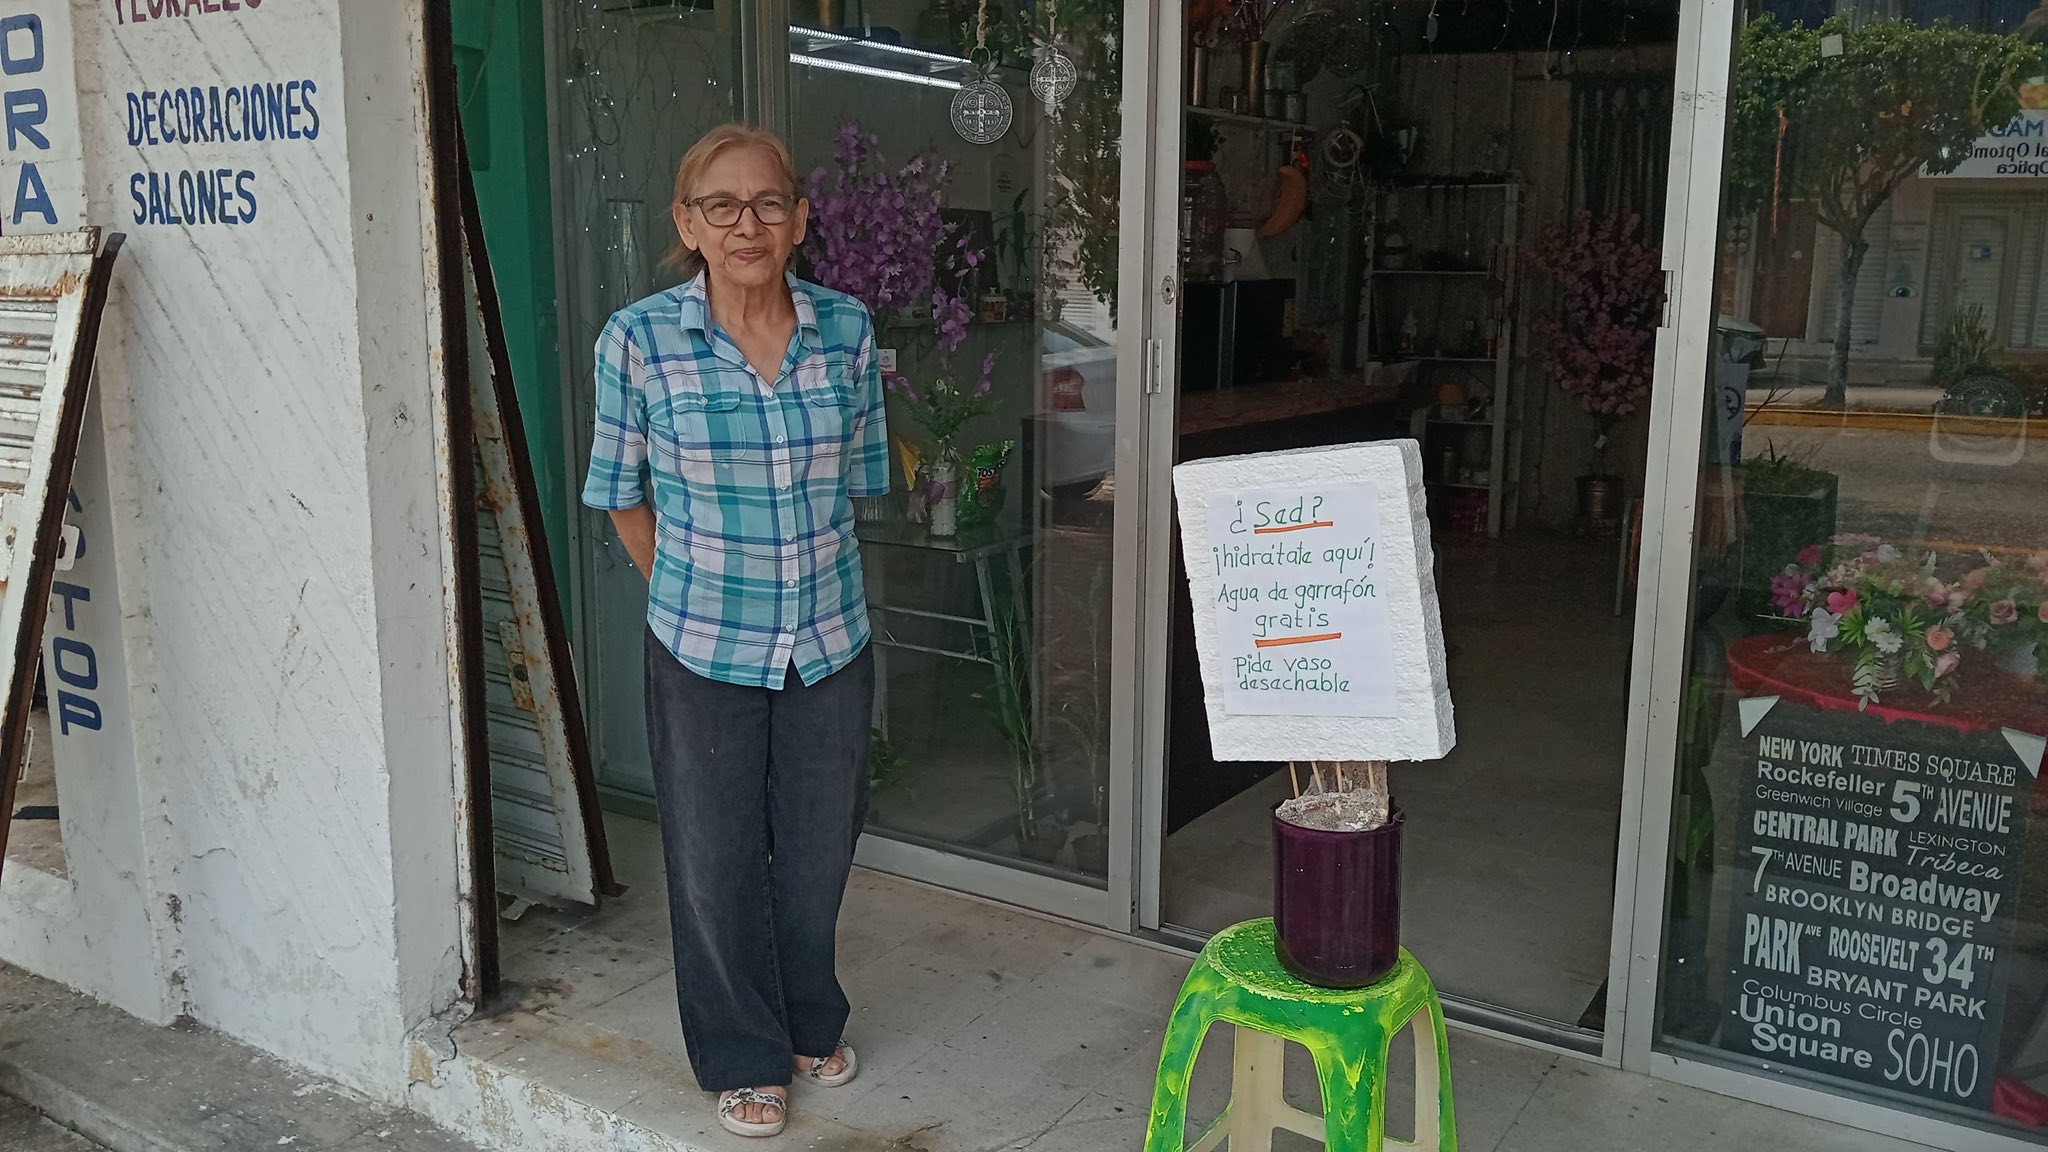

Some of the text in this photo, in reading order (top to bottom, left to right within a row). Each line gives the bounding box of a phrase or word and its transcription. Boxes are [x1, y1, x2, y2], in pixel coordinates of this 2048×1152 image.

[126, 79, 320, 147] DECORACIONES
[130, 169, 257, 226] SALONES
[1322, 536, 1376, 574] aquí!
[1217, 575, 1377, 612] Agua de garrafón
[1252, 606, 1330, 637] gratis
[1233, 652, 1333, 677] Pide vaso
[1757, 760, 1886, 796] Rockefeller
[1758, 735, 2017, 787] NEW YORK TIMES SQUARE
[1755, 784, 1884, 818] Greenwich Village
[1933, 786, 2014, 834] AVENUE
[1753, 810, 1899, 858] CENTRAL PARK
[1908, 830, 2007, 857] LEXINGTON
[1784, 851, 1843, 880] AVENUE
[1906, 845, 2004, 881] Tribeca
[1765, 883, 1975, 939] BROOKLYN BRIDGE
[1848, 860, 2001, 923] Broadway
[1743, 913, 1805, 976] PARK
[1804, 924, 1823, 938] AVE
[1828, 926, 1920, 973] ROOSEVELT
[1739, 993, 1841, 1038] Union
[1742, 978, 1924, 1030] Columbus Circle
[1806, 965, 1988, 1021] BRYANT PARK
[1750, 1022, 1874, 1069] Square
[1883, 1028, 1980, 1099] SOHO
